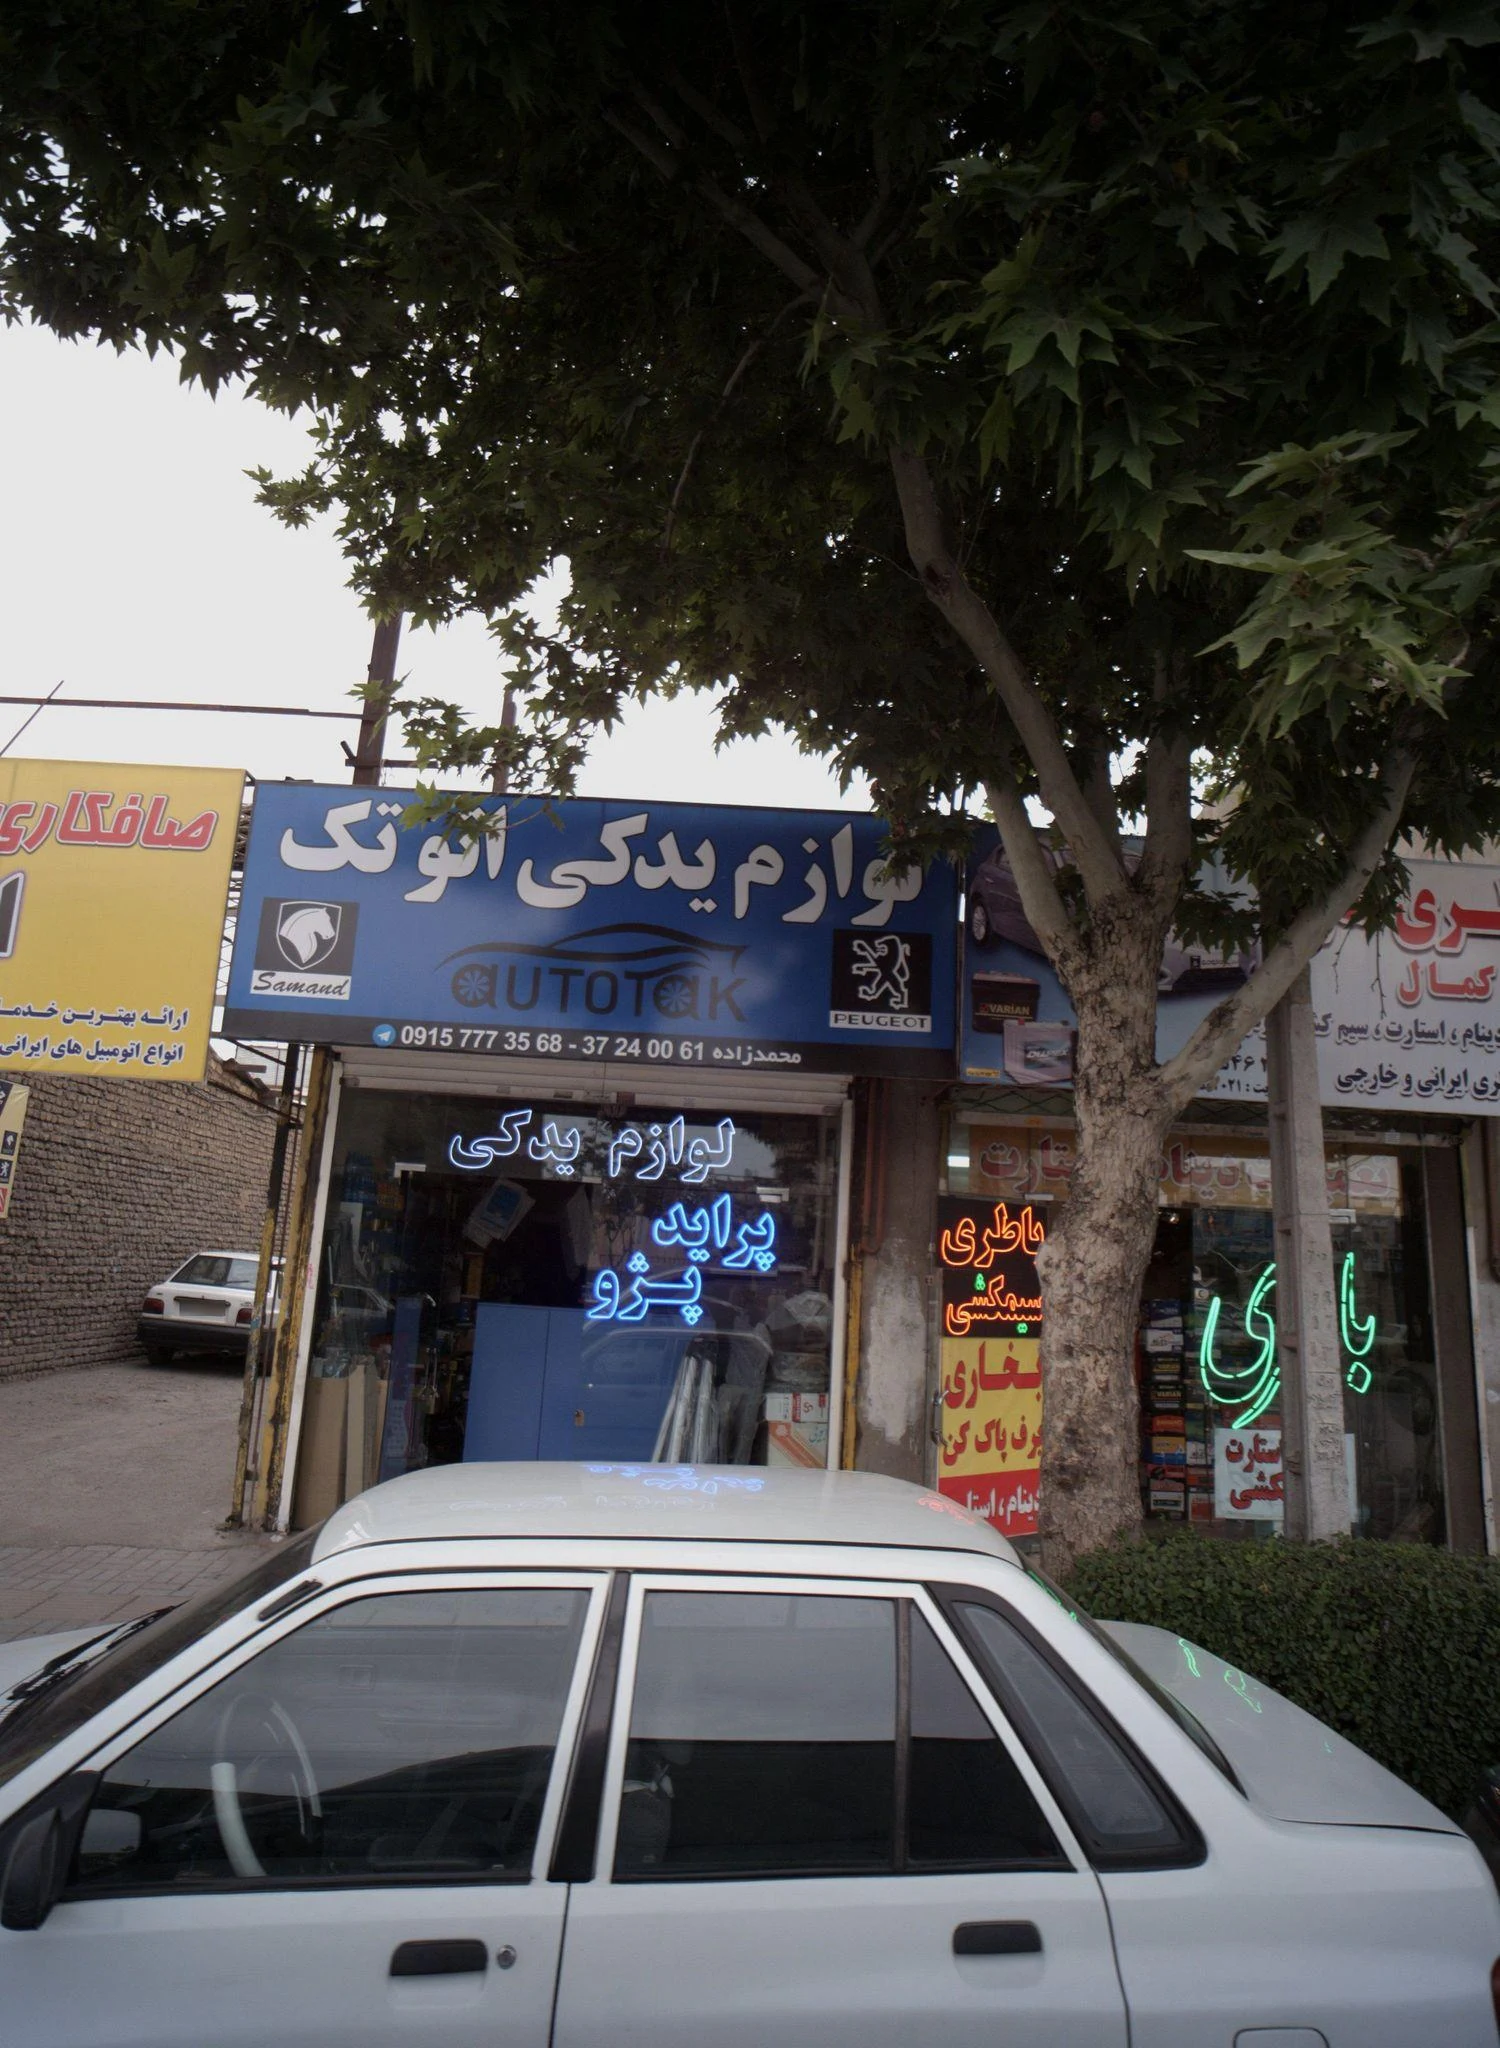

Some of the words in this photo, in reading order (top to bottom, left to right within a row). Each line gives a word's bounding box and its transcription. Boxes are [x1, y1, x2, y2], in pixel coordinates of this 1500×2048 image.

[279, 798, 402, 874] تک
[516, 812, 716, 913] یدکی
[252, 971, 350, 996] Samand
[1399, 960, 1494, 1004] کمال
[0, 1001, 59, 1019] خدم
[62, 1008, 137, 1028] بهترین
[141, 1009, 189, 1031] ارائه
[832, 1013, 930, 1031] PEUGEOT
[0, 1035, 49, 1058] ایرانی
[51, 1037, 83, 1060] های
[401, 1026, 453, 1047] 0915
[460, 1029, 499, 1050] 777
[504, 1031, 530, 1051] 35
[536, 1033, 562, 1053] 68
[583, 1036, 608, 1055] 37
[615, 1038, 641, 1058] 24
[648, 1039, 674, 1060] 00
[680, 1041, 705, 1062] 61
[712, 1044, 803, 1066] محمدزاده
[1338, 1023, 1370, 1043] سیم
[1386, 1019, 1446, 1046] استارت
[86, 1040, 141, 1063] اتومبیل
[144, 1046, 184, 1066] انواع
[1338, 1063, 1398, 1090] خارجی
[1403, 1072, 1413, 1093] و
[1419, 1067, 1468, 1095] ایرانی
[447, 1108, 582, 1176] یدکی
[608, 1113, 737, 1183] لوازم
[650, 1192, 777, 1272] پراید
[941, 1202, 1046, 1268] باطری
[586, 1251, 705, 1327] پژو
[1199, 1250, 1376, 1431] باری
[945, 1342, 1042, 1409] بخاری
[942, 1421, 971, 1466] کن
[974, 1417, 1007, 1464] پاک
[1225, 1433, 1281, 1473] ستارت
